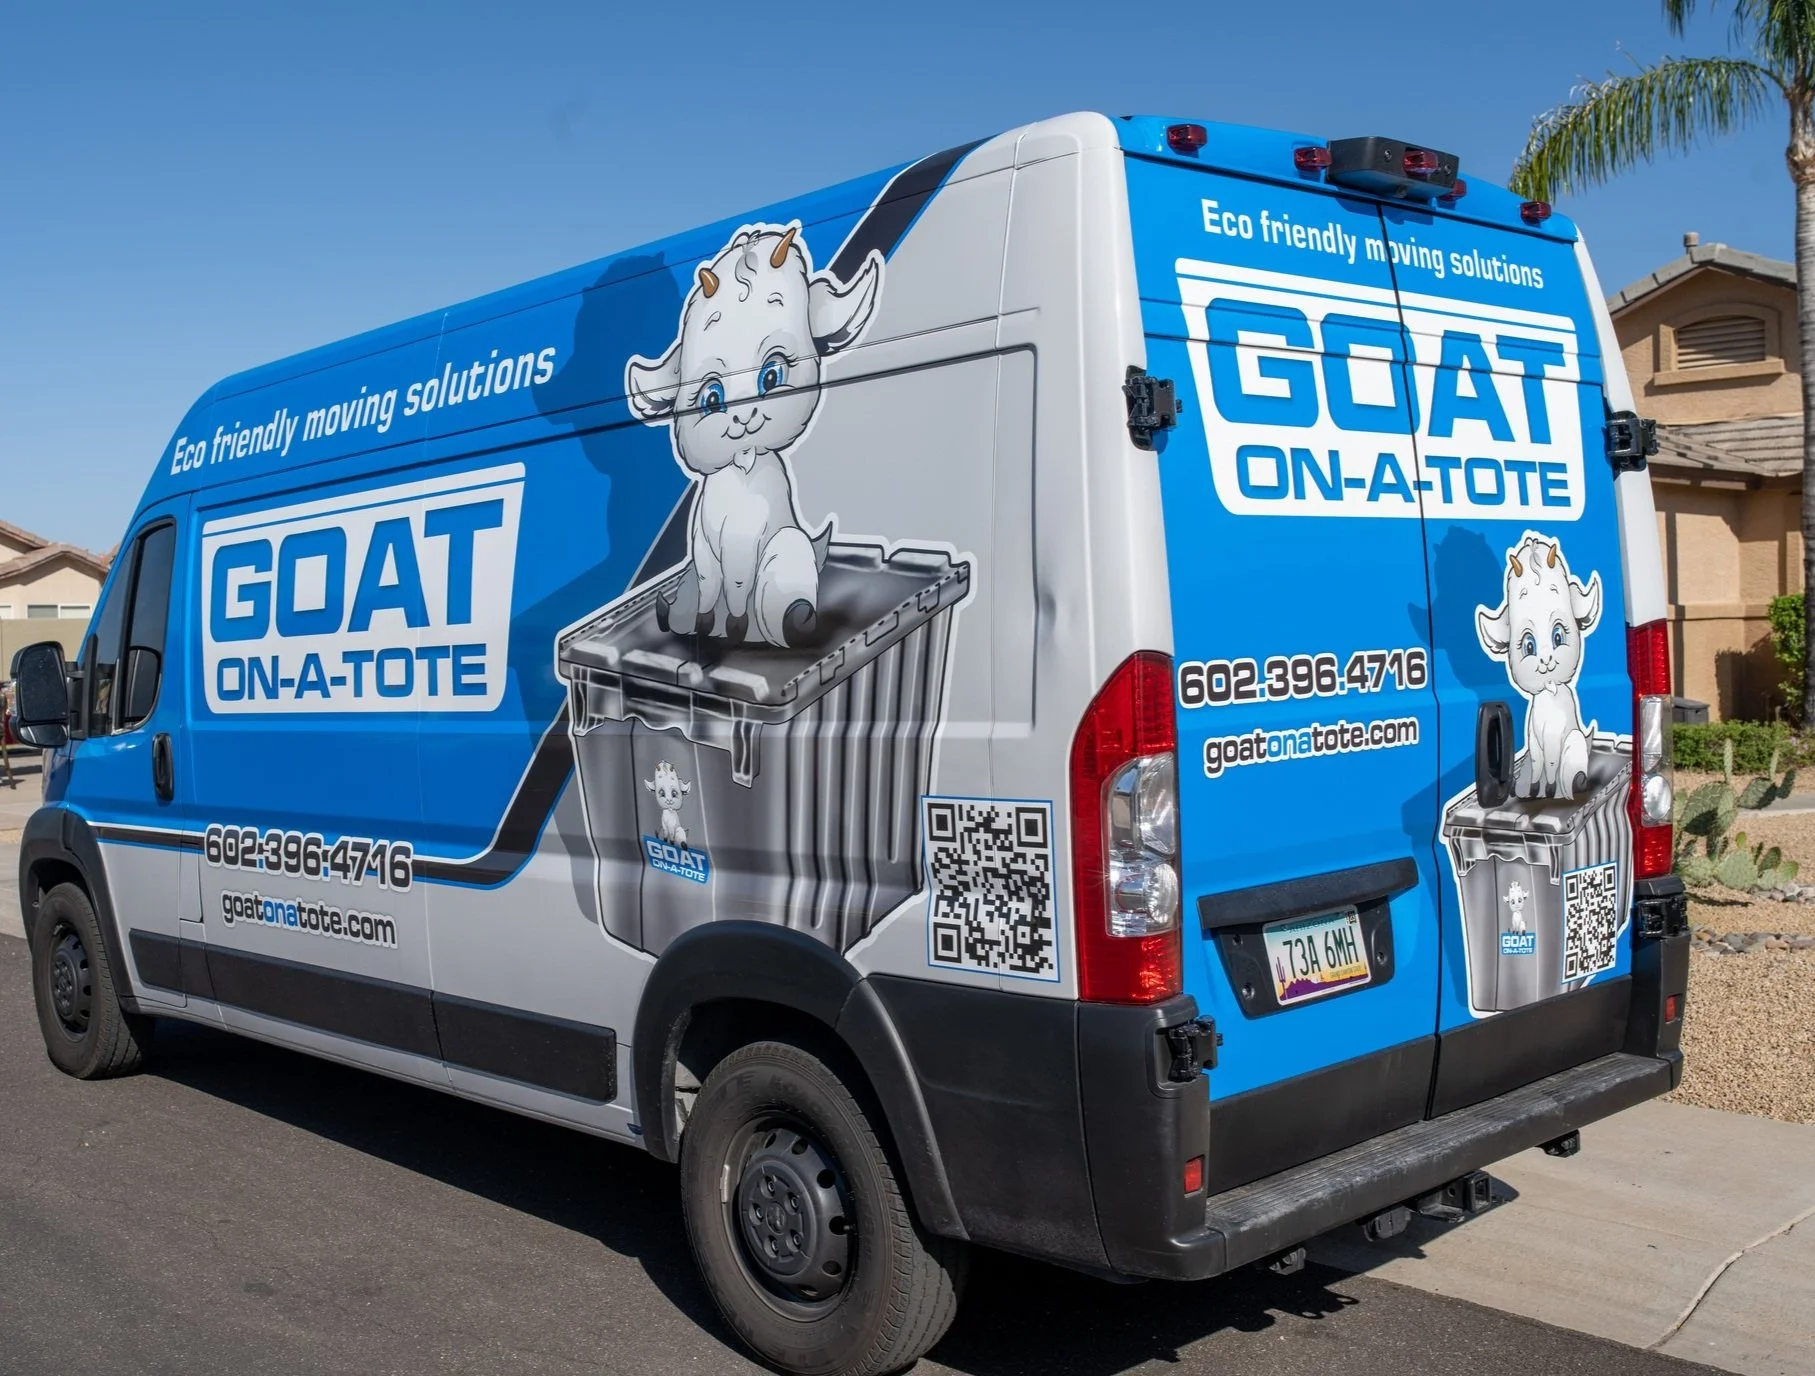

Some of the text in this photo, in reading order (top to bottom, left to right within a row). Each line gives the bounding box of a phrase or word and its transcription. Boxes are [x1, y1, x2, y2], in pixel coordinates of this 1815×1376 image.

[1201, 199, 1545, 290] Eco friendly moving solutions
[1205, 297, 1568, 446] GOAT
[170, 346, 556, 476] Eco friendly moving solutions
[1236, 444, 1572, 508] ON-A-TOTE
[210, 498, 505, 643] GOAT
[216, 643, 488, 702] ON-A-TOTE
[1179, 649, 1427, 707] 602.396.4716
[1204, 718, 1419, 777] goatonatote.com
[205, 824, 413, 891] 602.396.4716
[647, 840, 706, 871] GOAT
[652, 858, 706, 882] ON-A-TOTE
[221, 891, 398, 947] goatonatote.com
[1502, 935, 1533, 947] GOAT
[1282, 926, 1359, 979] 73A 6MH
